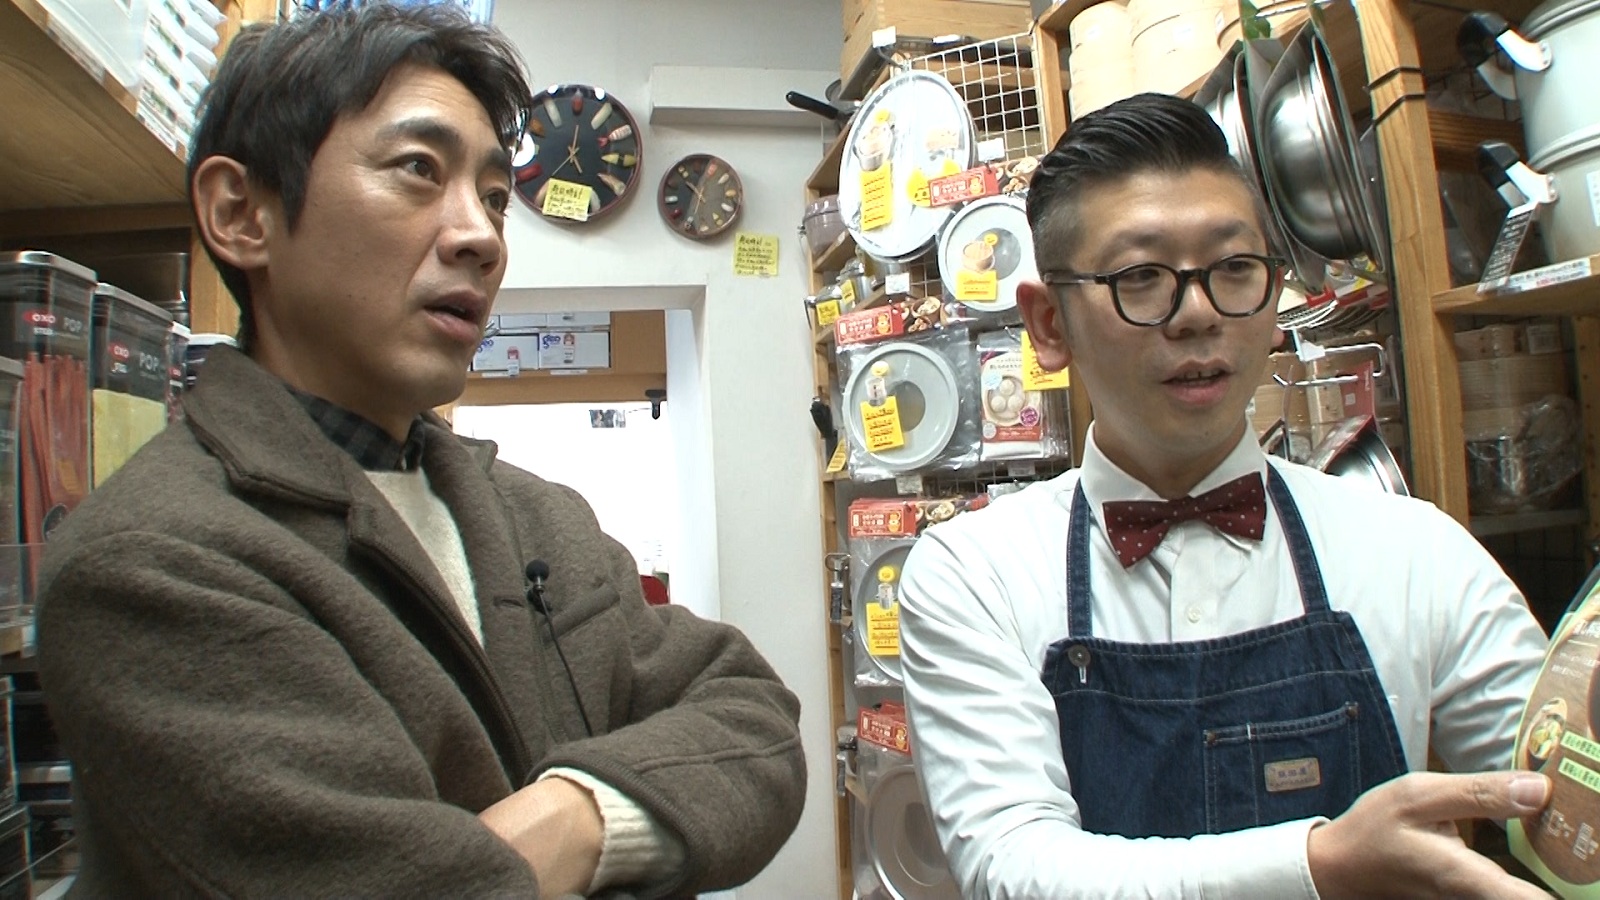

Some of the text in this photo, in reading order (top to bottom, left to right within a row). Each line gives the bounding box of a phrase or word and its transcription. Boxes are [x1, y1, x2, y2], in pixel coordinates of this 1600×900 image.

[32, 313, 82, 333] OXO POP
[139, 352, 160, 372] POP
